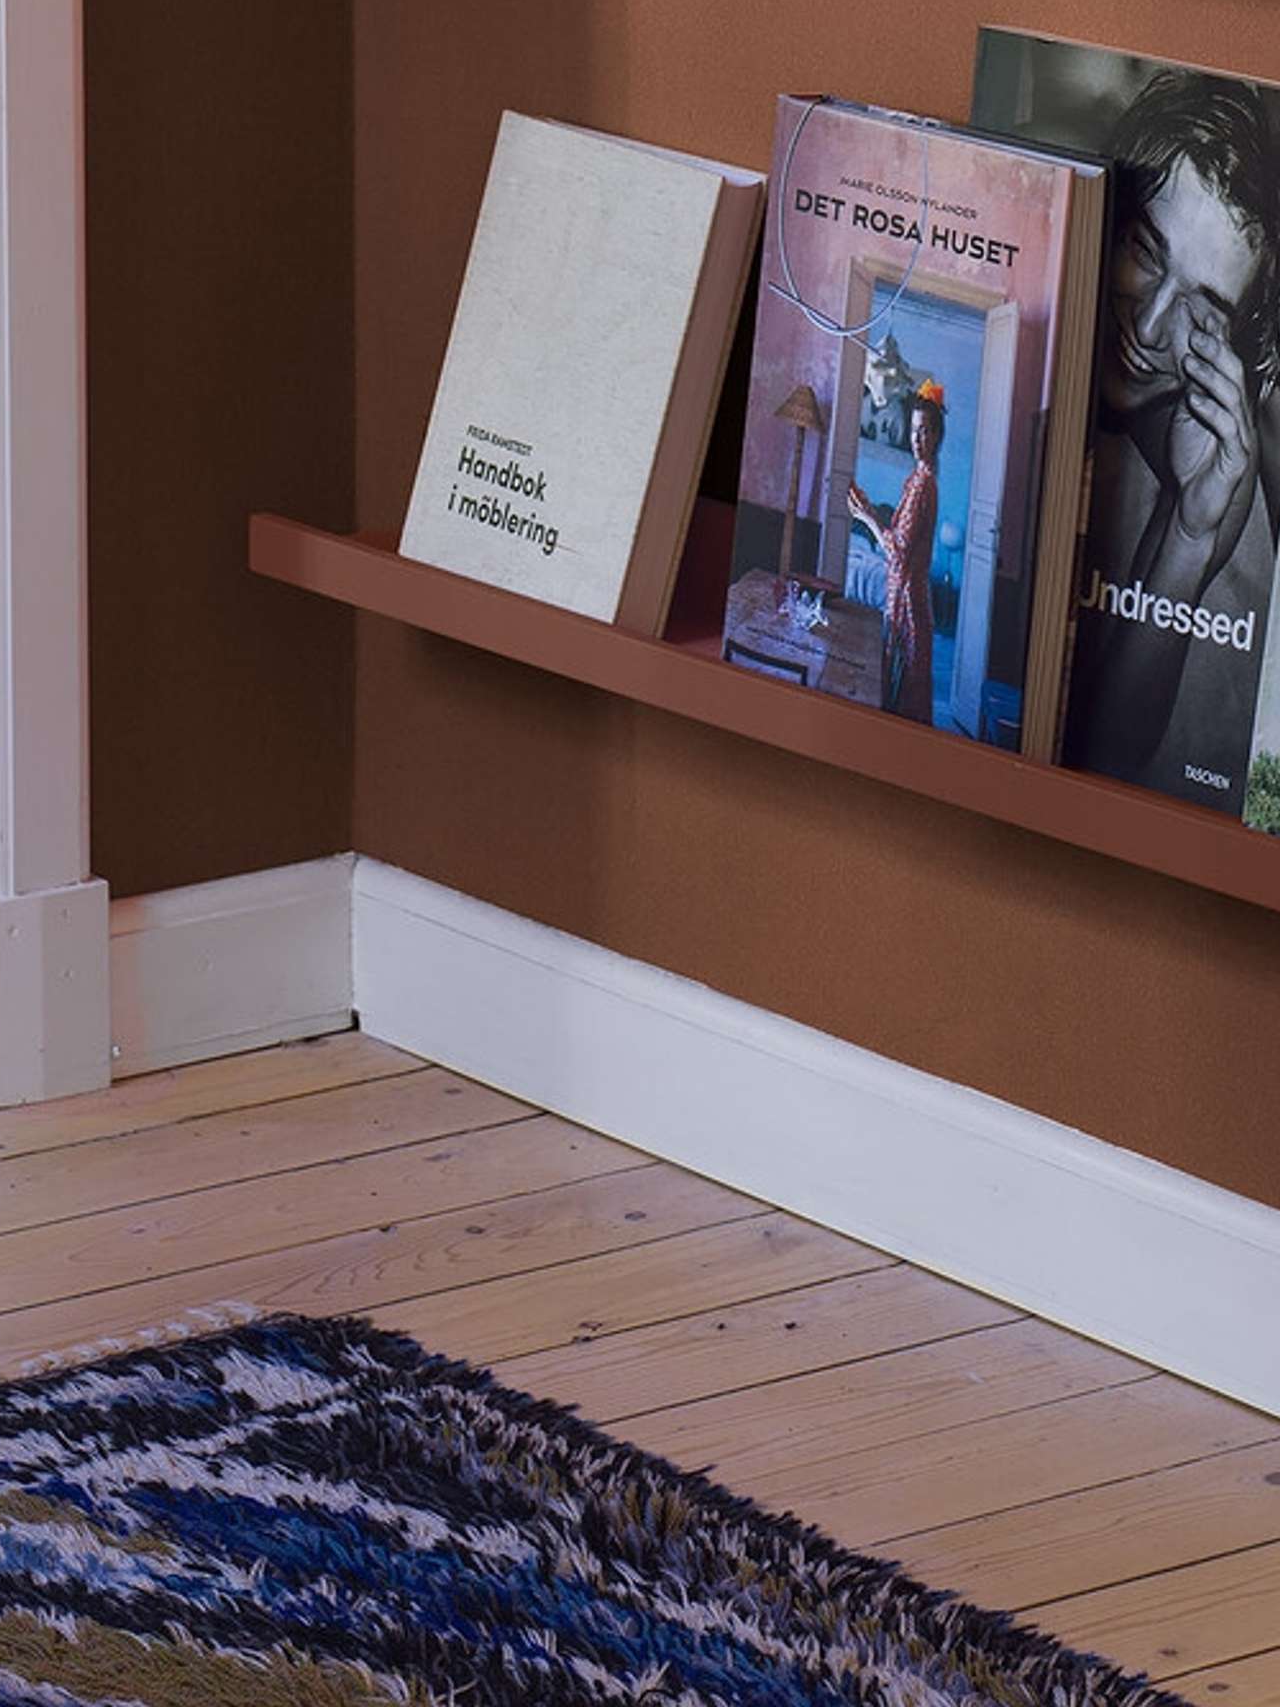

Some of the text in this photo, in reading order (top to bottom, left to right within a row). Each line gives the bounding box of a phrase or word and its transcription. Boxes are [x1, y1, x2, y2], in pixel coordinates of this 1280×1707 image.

[839, 176, 873, 194] MARIE
[875, 184, 918, 205] OLSSON
[794, 189, 1020, 267] DET ROSA HUSET
[458, 446, 547, 502] Handbok
[448, 484, 559, 556] i möblering
